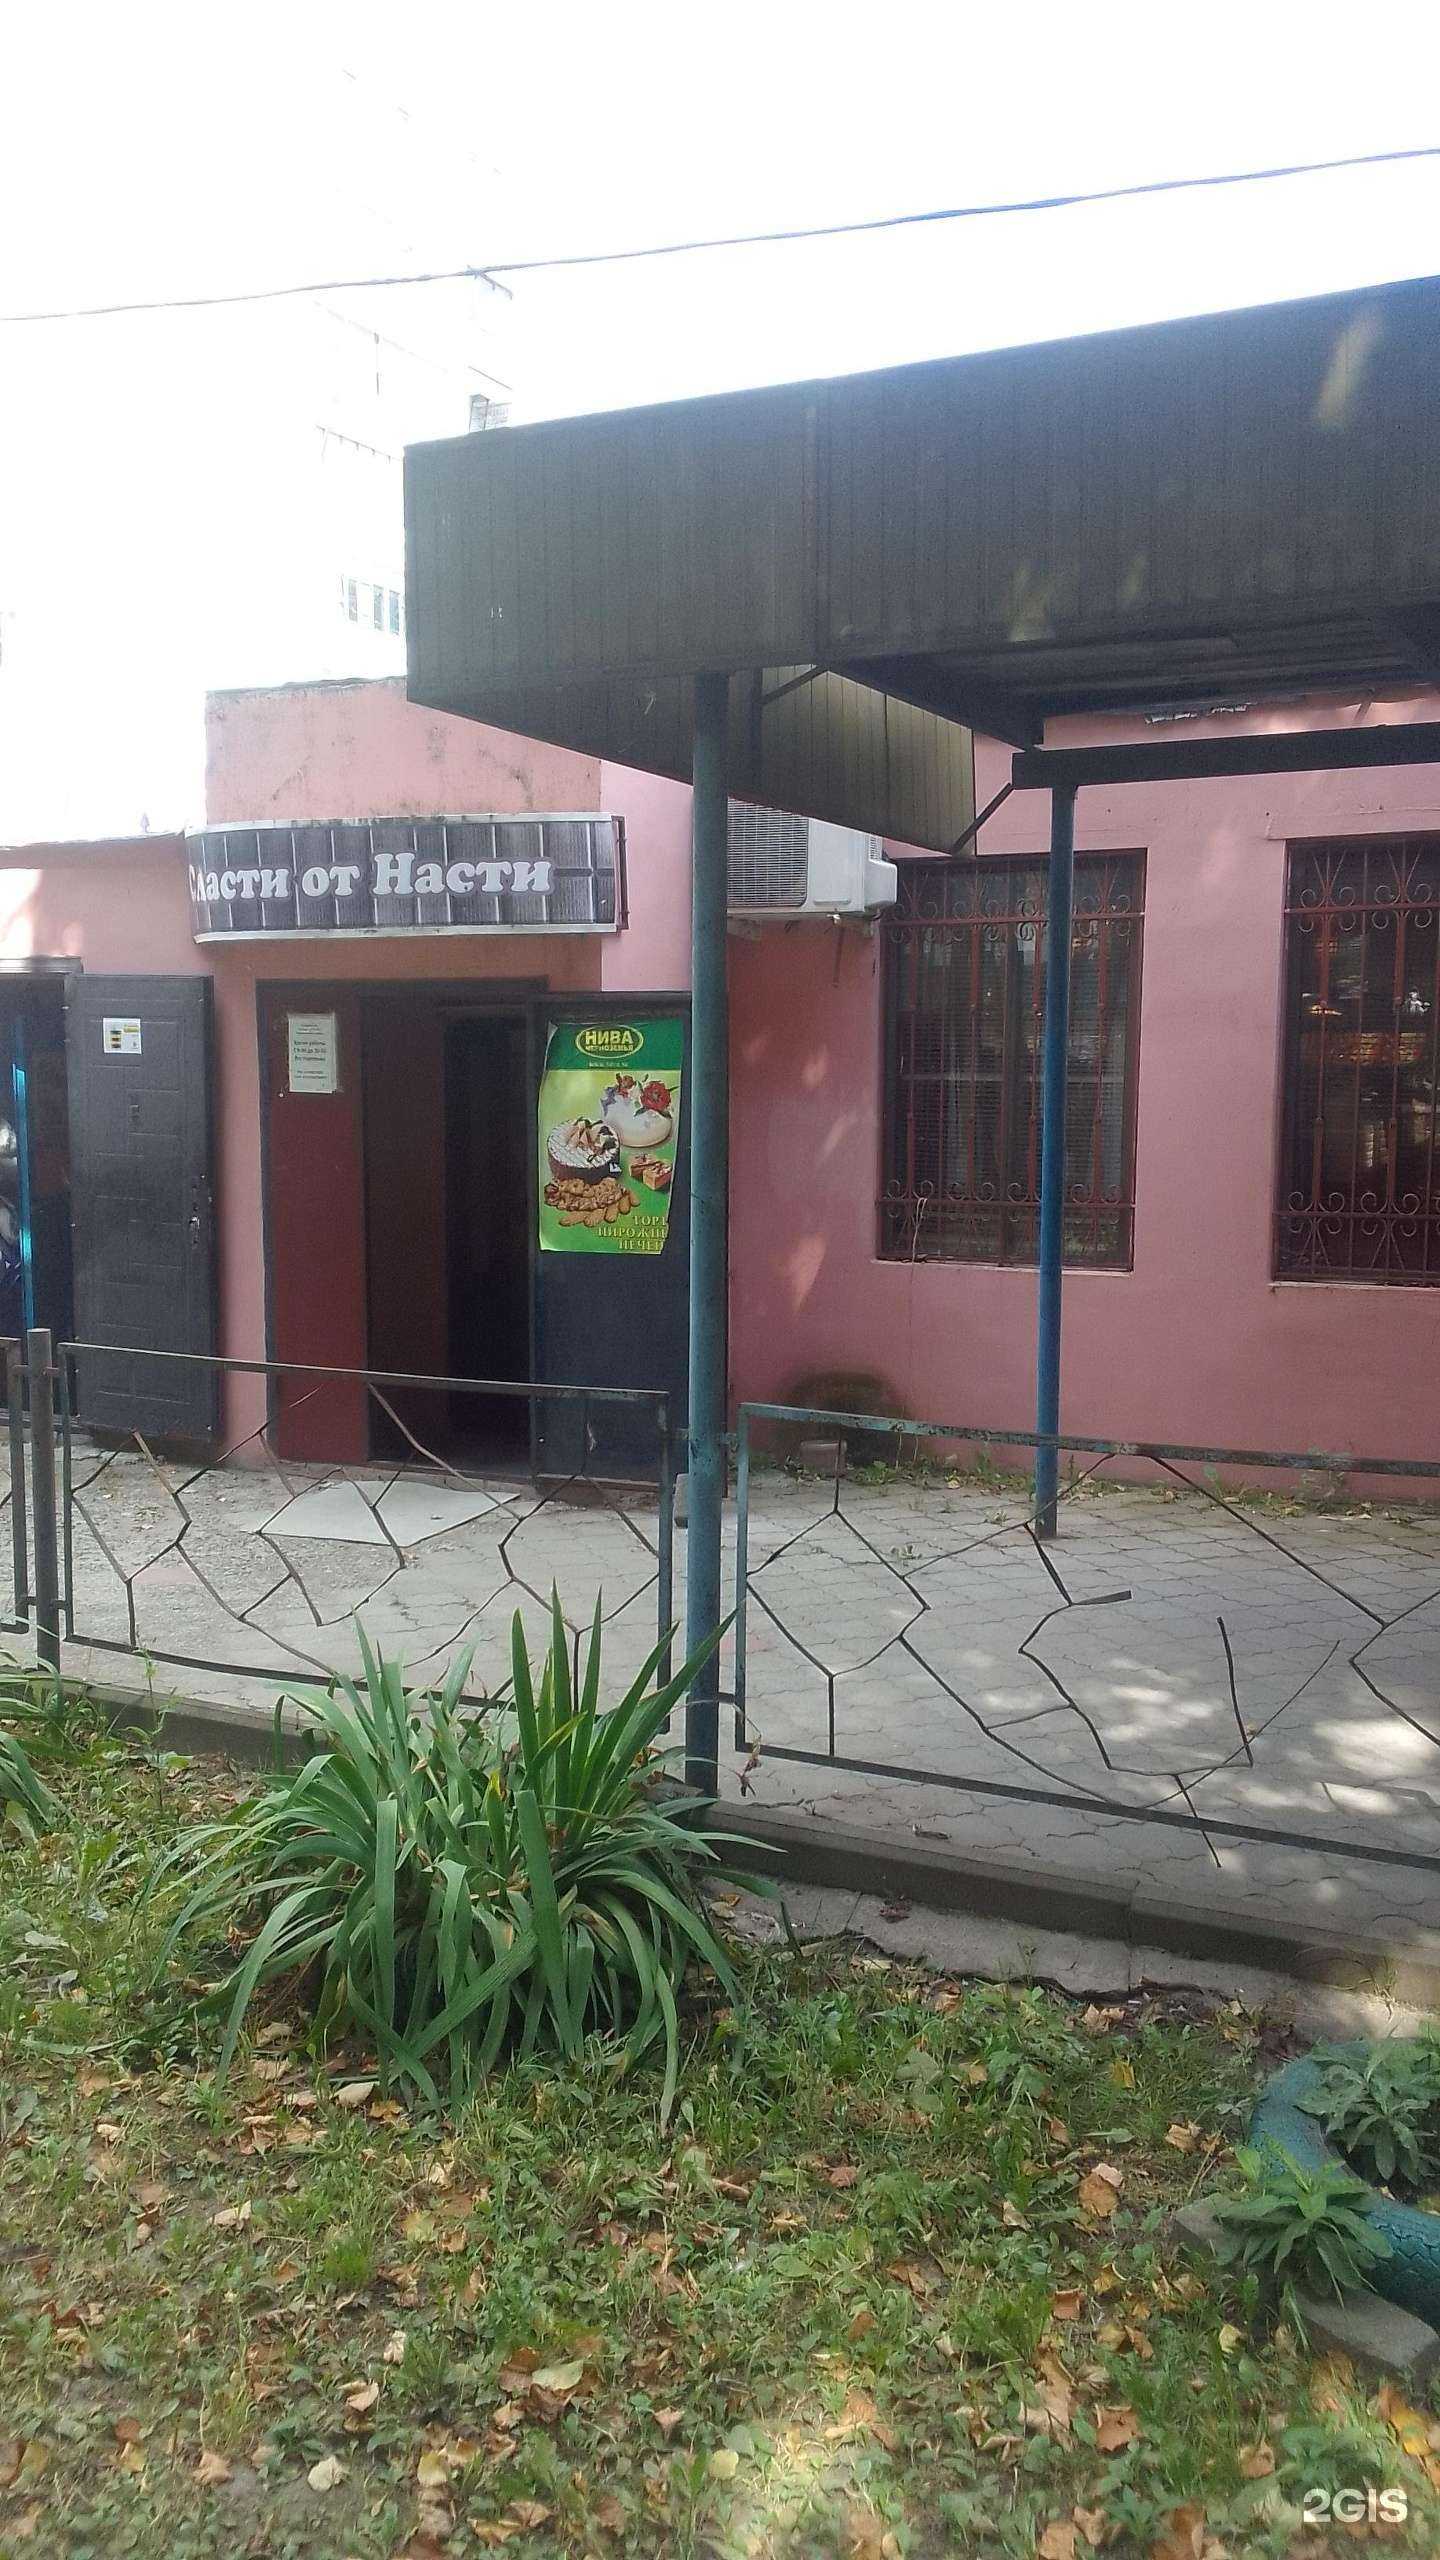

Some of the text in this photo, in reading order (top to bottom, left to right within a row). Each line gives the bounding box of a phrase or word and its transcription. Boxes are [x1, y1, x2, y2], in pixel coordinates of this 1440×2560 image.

[300, 865, 361, 897] от
[372, 852, 552, 897] Насти
[585, 1030, 634, 1045] НИВА
